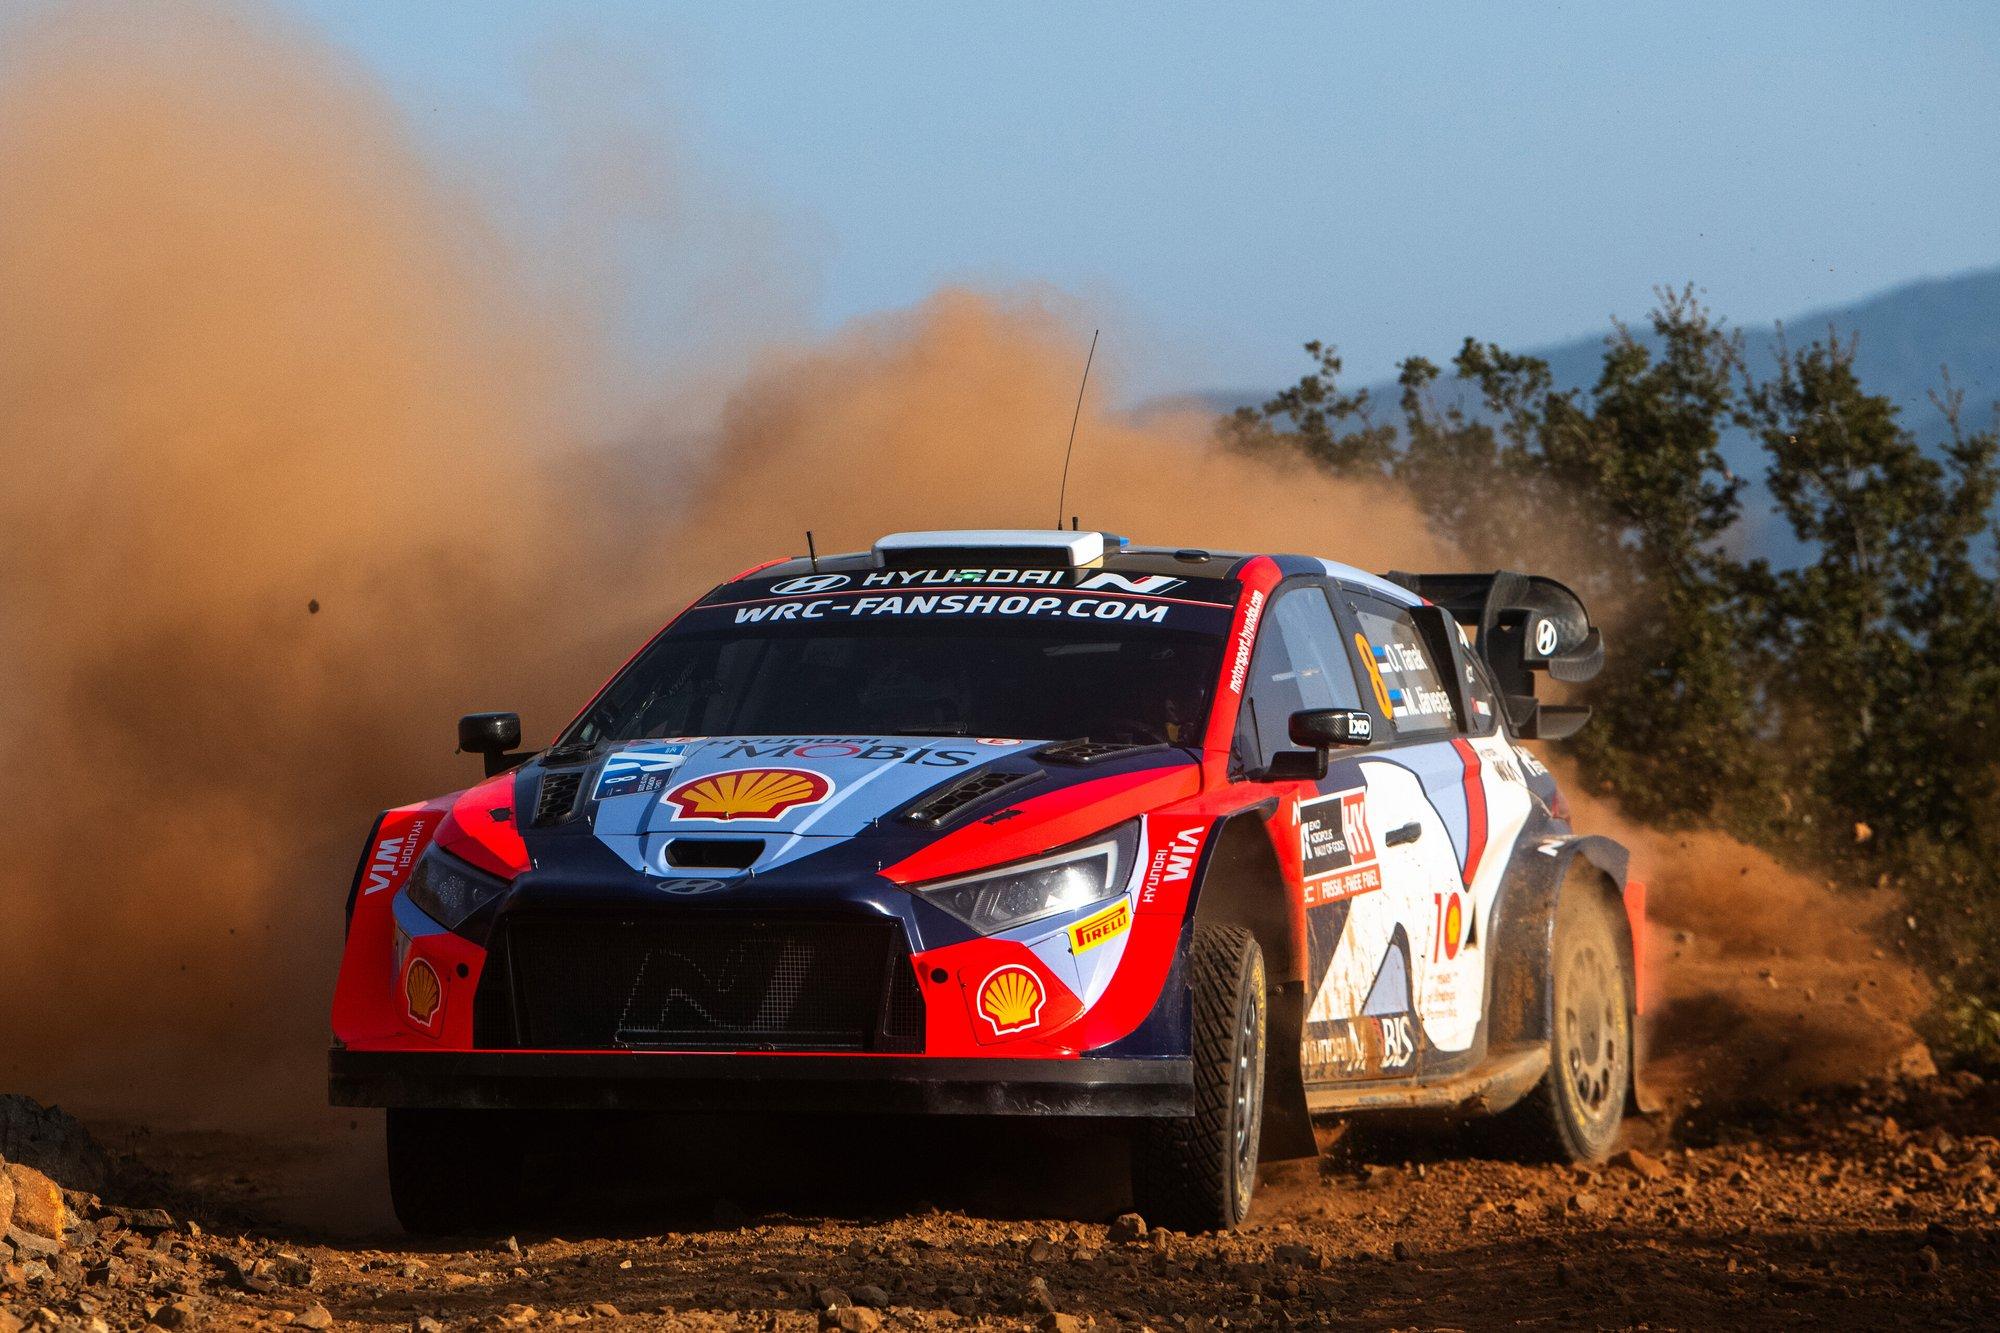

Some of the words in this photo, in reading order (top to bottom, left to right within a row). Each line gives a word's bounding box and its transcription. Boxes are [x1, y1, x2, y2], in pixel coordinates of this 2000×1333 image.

[862, 570, 1064, 586] HYUNDAI
[734, 595, 1170, 624] WRC-FANSHOP.COM
[1230, 589, 1264, 695] motorsport.hyundai.com
[1354, 632, 1393, 720] 8
[704, 738, 881, 747] HYUNDAI
[718, 743, 977, 767] MOBIS
[399, 820, 425, 867] HYUNDAI
[1142, 849, 1169, 903] HYUNDAI
[1075, 906, 1127, 947] PIRELLI
